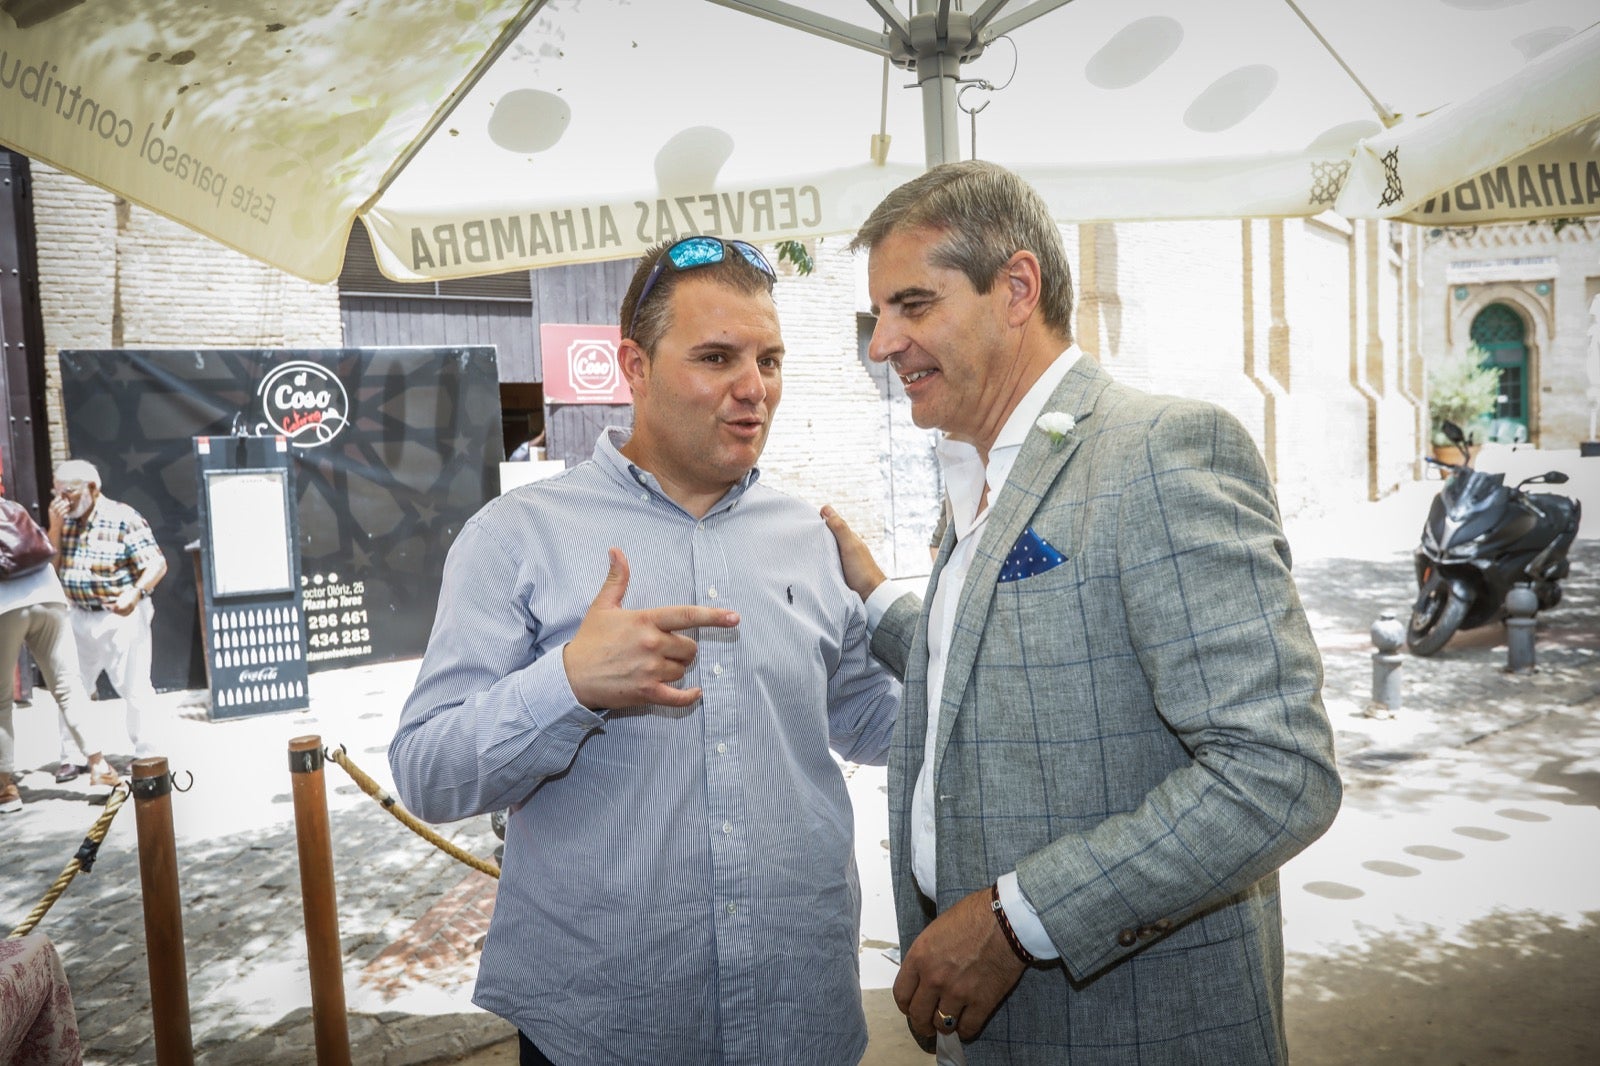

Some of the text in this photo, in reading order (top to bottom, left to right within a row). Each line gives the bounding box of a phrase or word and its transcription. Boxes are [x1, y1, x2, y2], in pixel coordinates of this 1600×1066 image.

[275, 384, 331, 410] Coso
[302, 587, 326, 599] octor
[303, 595, 363, 611] Plaza de Toros
[308, 609, 368, 630] 296 461
[309, 628, 370, 648] 434 283
